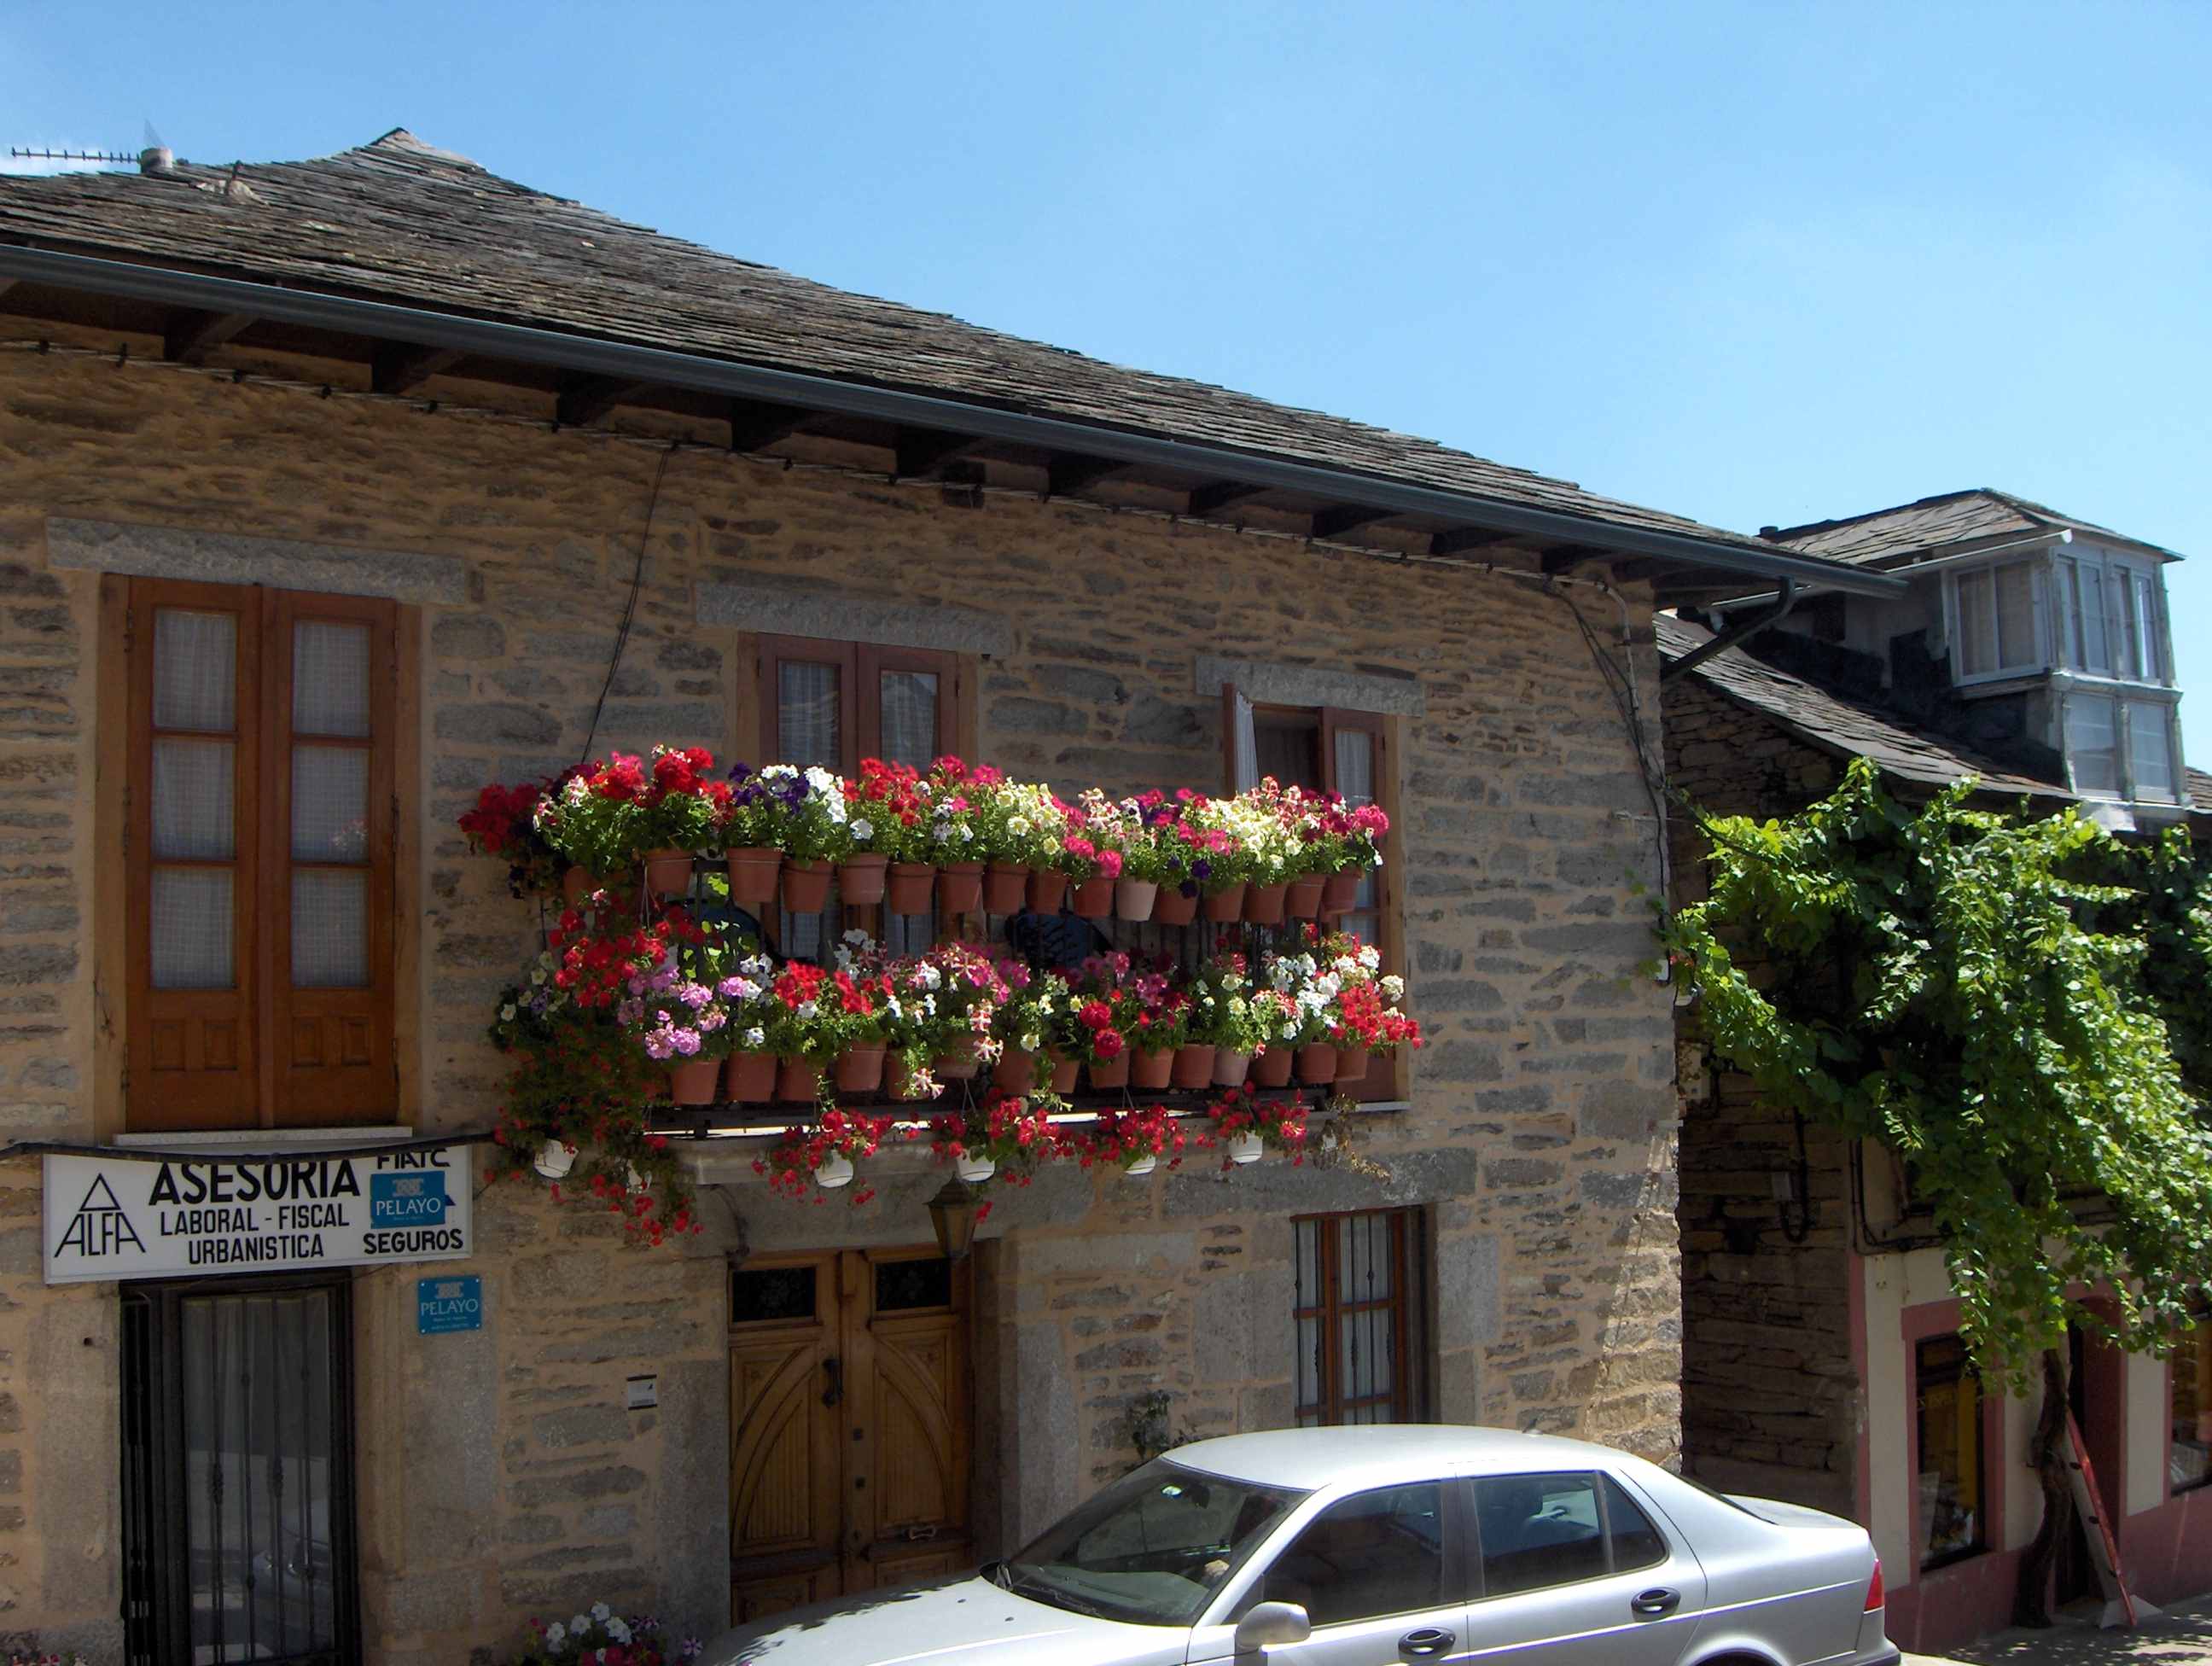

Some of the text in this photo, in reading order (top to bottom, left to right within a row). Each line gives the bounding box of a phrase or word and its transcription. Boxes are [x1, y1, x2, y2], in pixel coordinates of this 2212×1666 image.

[377, 1147, 451, 1169] FIATC
[148, 1158, 361, 1205] ASESORIA
[160, 1208, 259, 1236] LABORAL
[279, 1203, 350, 1230] FISCAL
[375, 1197, 441, 1216] PELAYO
[54, 1212, 146, 1258] ALFA
[189, 1233, 324, 1265] URBANISTICA
[363, 1228, 464, 1255] SEGUROS
[421, 1298, 479, 1316] PELAYO
